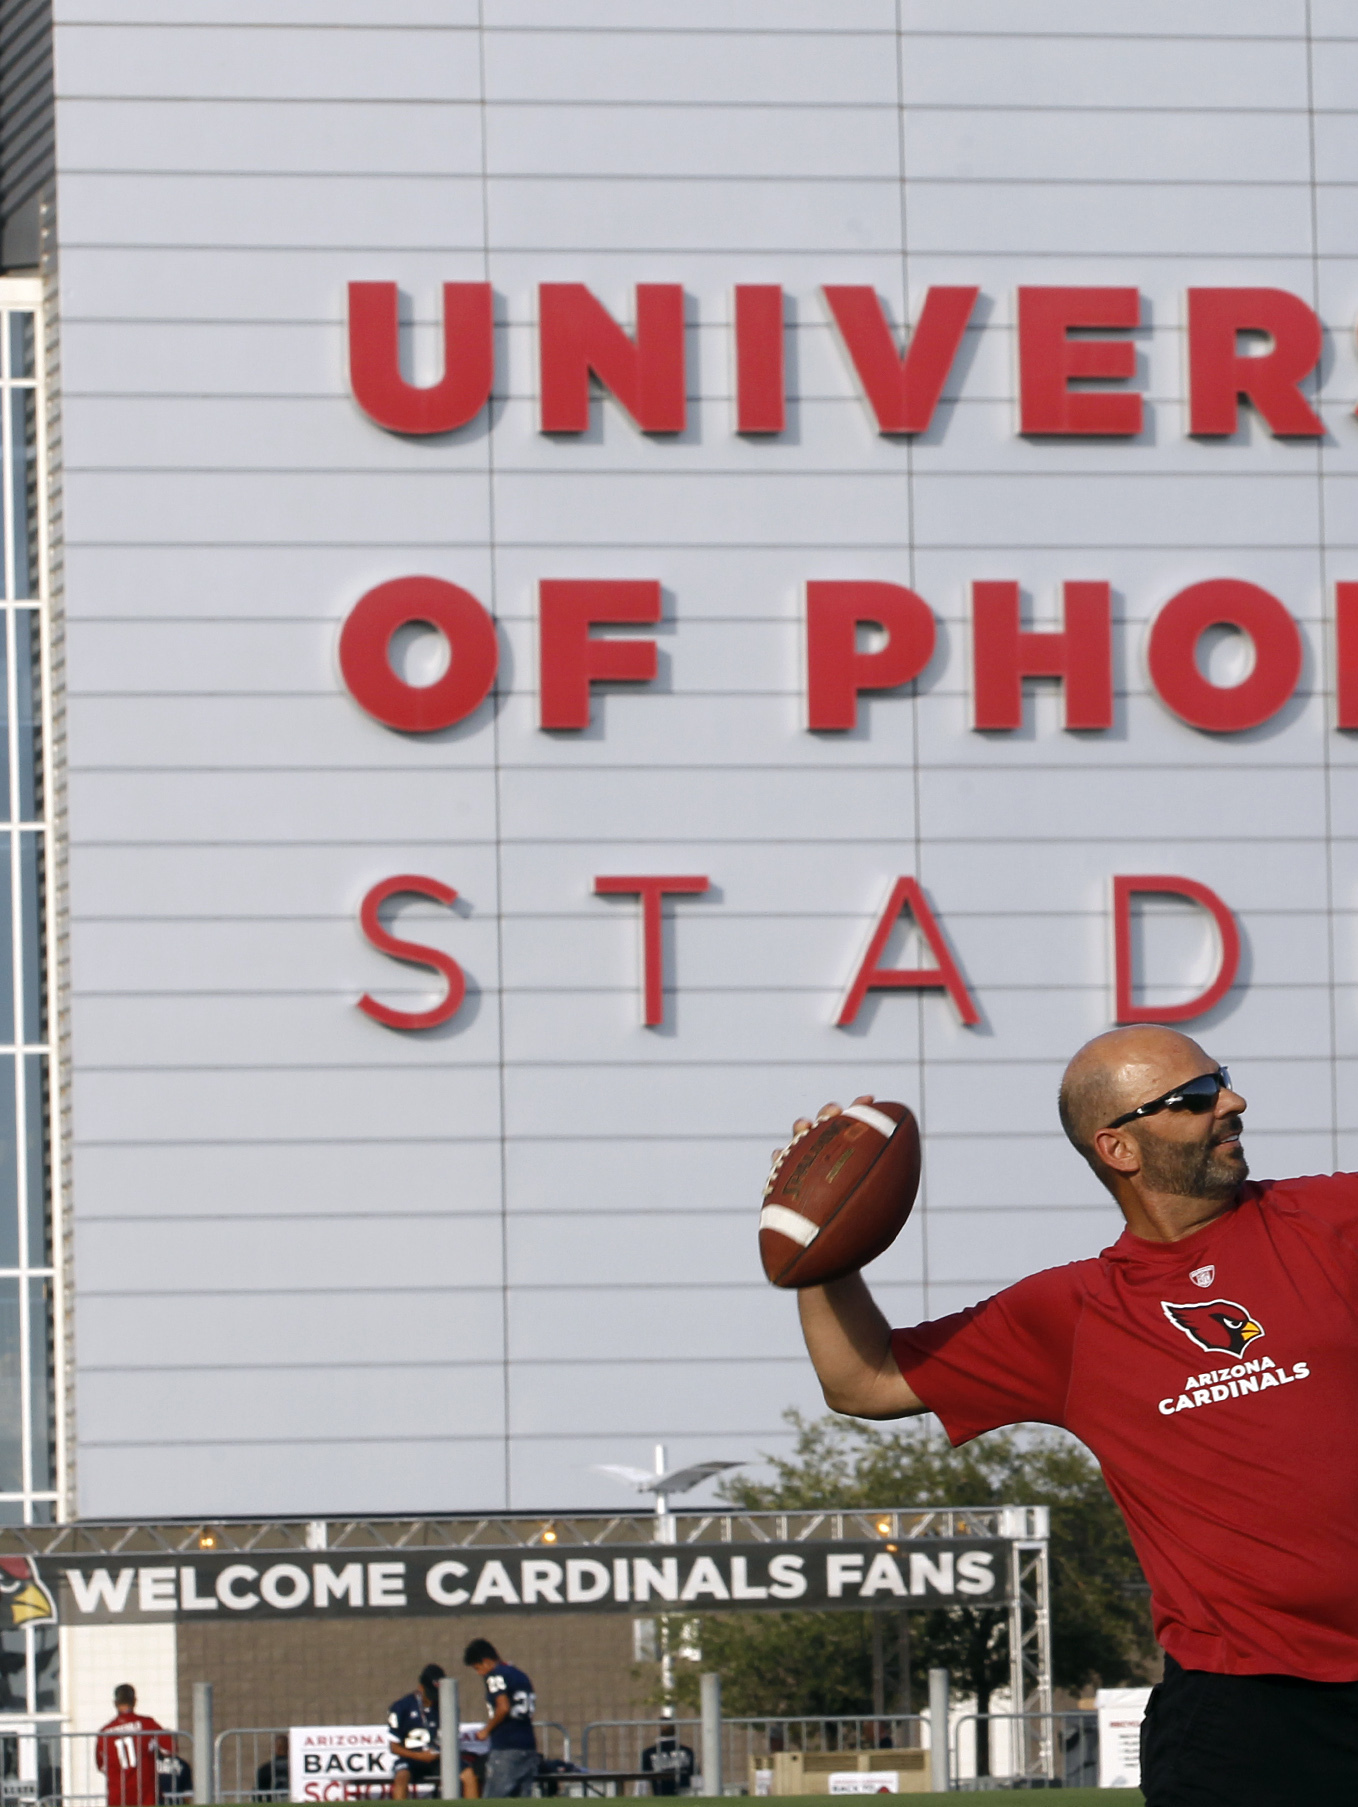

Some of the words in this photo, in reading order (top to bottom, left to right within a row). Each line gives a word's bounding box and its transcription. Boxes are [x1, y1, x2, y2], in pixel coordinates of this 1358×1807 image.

[338, 576, 663, 734] OF
[1157, 1361, 1311, 1416] CARDINALS
[1184, 1356, 1276, 1391] ARIZONA
[65, 1563, 407, 1614] WELCOME
[426, 1554, 807, 1607] CARDINALS
[826, 1551, 995, 1597] FANS
[114, 1736, 137, 1770] 11
[304, 1734, 386, 1747] ARIZONA
[303, 1752, 386, 1774] BACK
